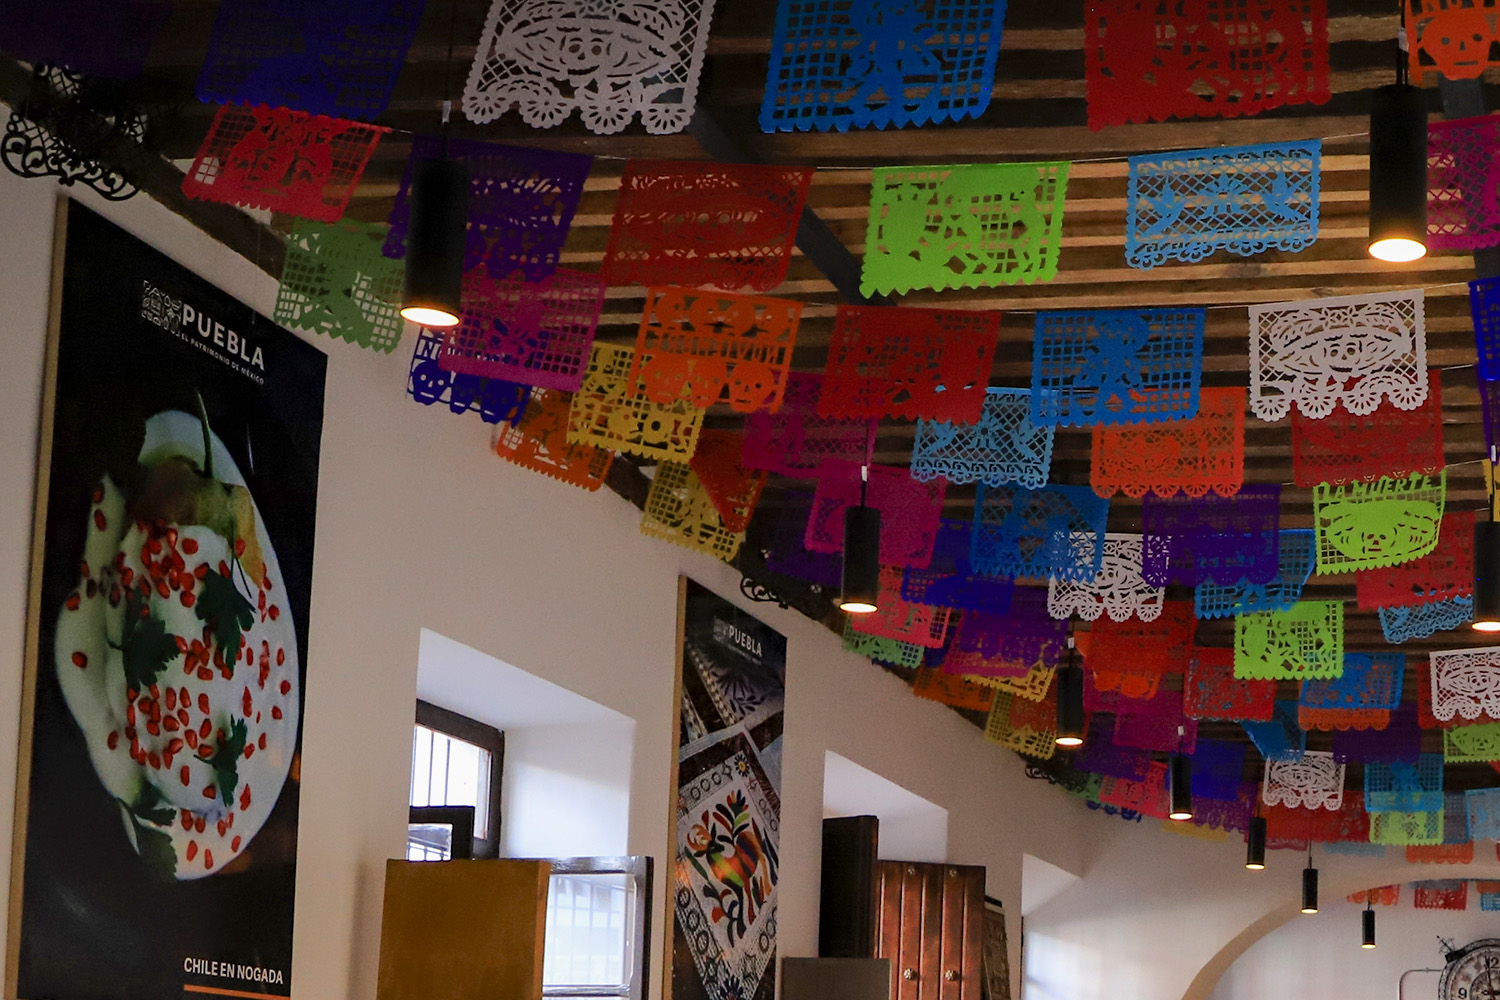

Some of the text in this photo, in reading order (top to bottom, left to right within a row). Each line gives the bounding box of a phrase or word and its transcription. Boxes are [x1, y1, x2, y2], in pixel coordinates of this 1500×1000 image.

[182, 303, 264, 371] PUEBLA
[182, 333, 189, 342] EL
[190, 338, 230, 365] PATRIMONIO
[231, 361, 240, 371] DE
[1352, 475, 1432, 499] MUERTE
[729, 625, 762, 657] PUEBLA
[184, 957, 283, 985] CHILE EN NOGADA
[1458, 987, 1468, 1000] 9
